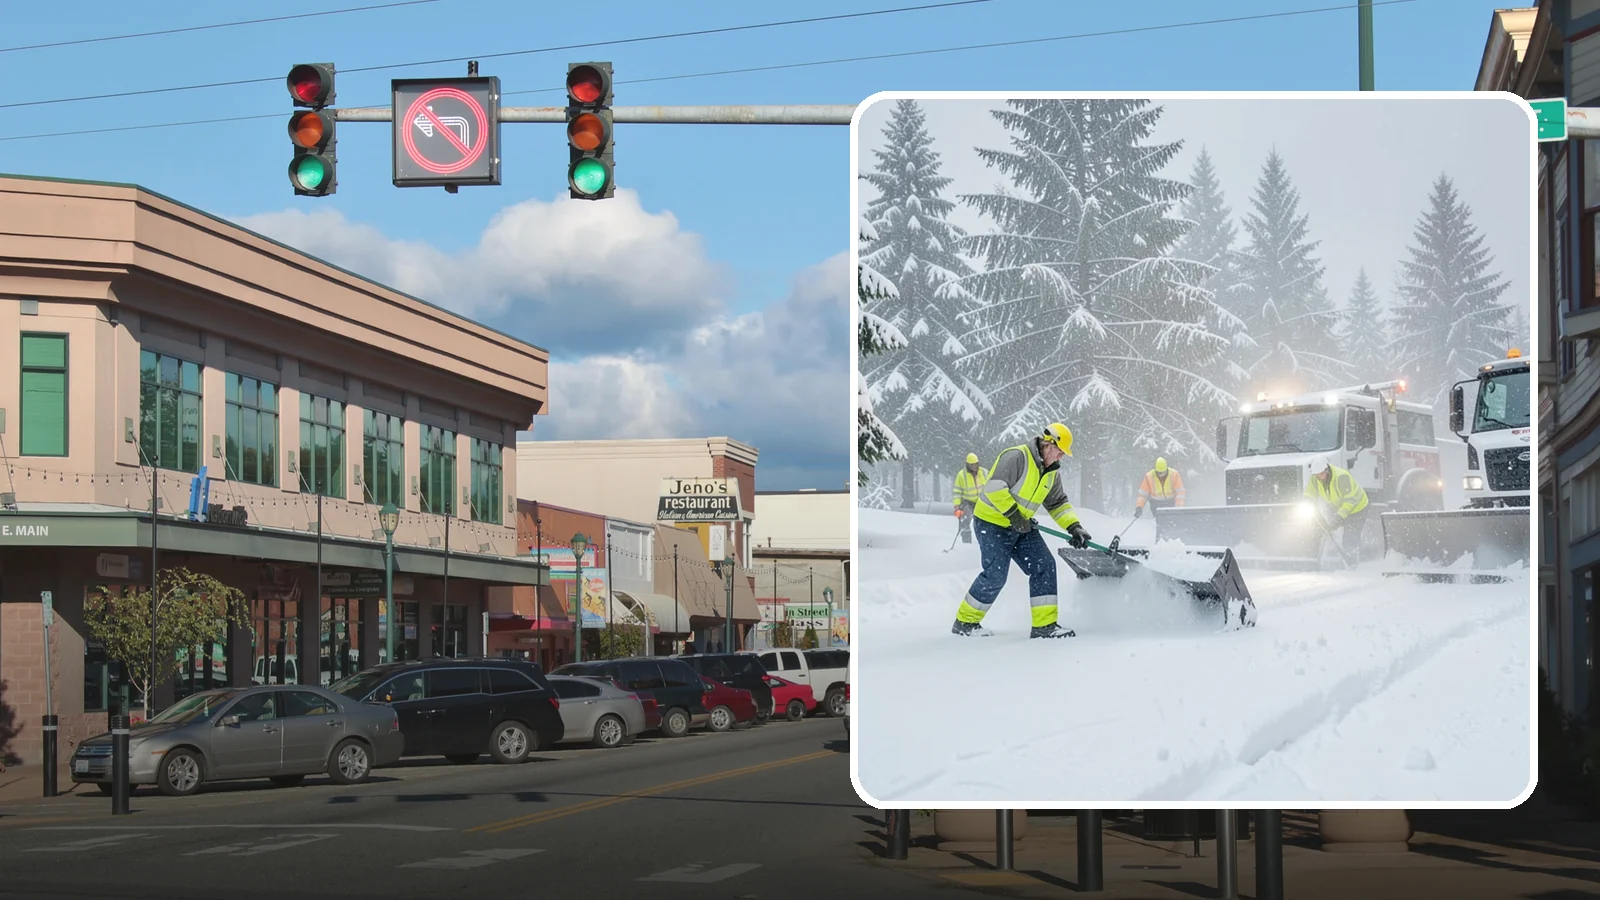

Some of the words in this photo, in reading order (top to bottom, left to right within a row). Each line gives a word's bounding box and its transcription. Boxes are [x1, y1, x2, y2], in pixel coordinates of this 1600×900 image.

[670, 480, 728, 494] Jeno's
[665, 497, 731, 509] restaurant
[658, 510, 681, 519] Italian
[686, 510, 714, 519] American
[715, 510, 737, 519] Cuisine
[2, 525, 13, 536] E.
[15, 525, 49, 536] MAIN
[797, 608, 828, 617] Street
[790, 619, 823, 627] lass
